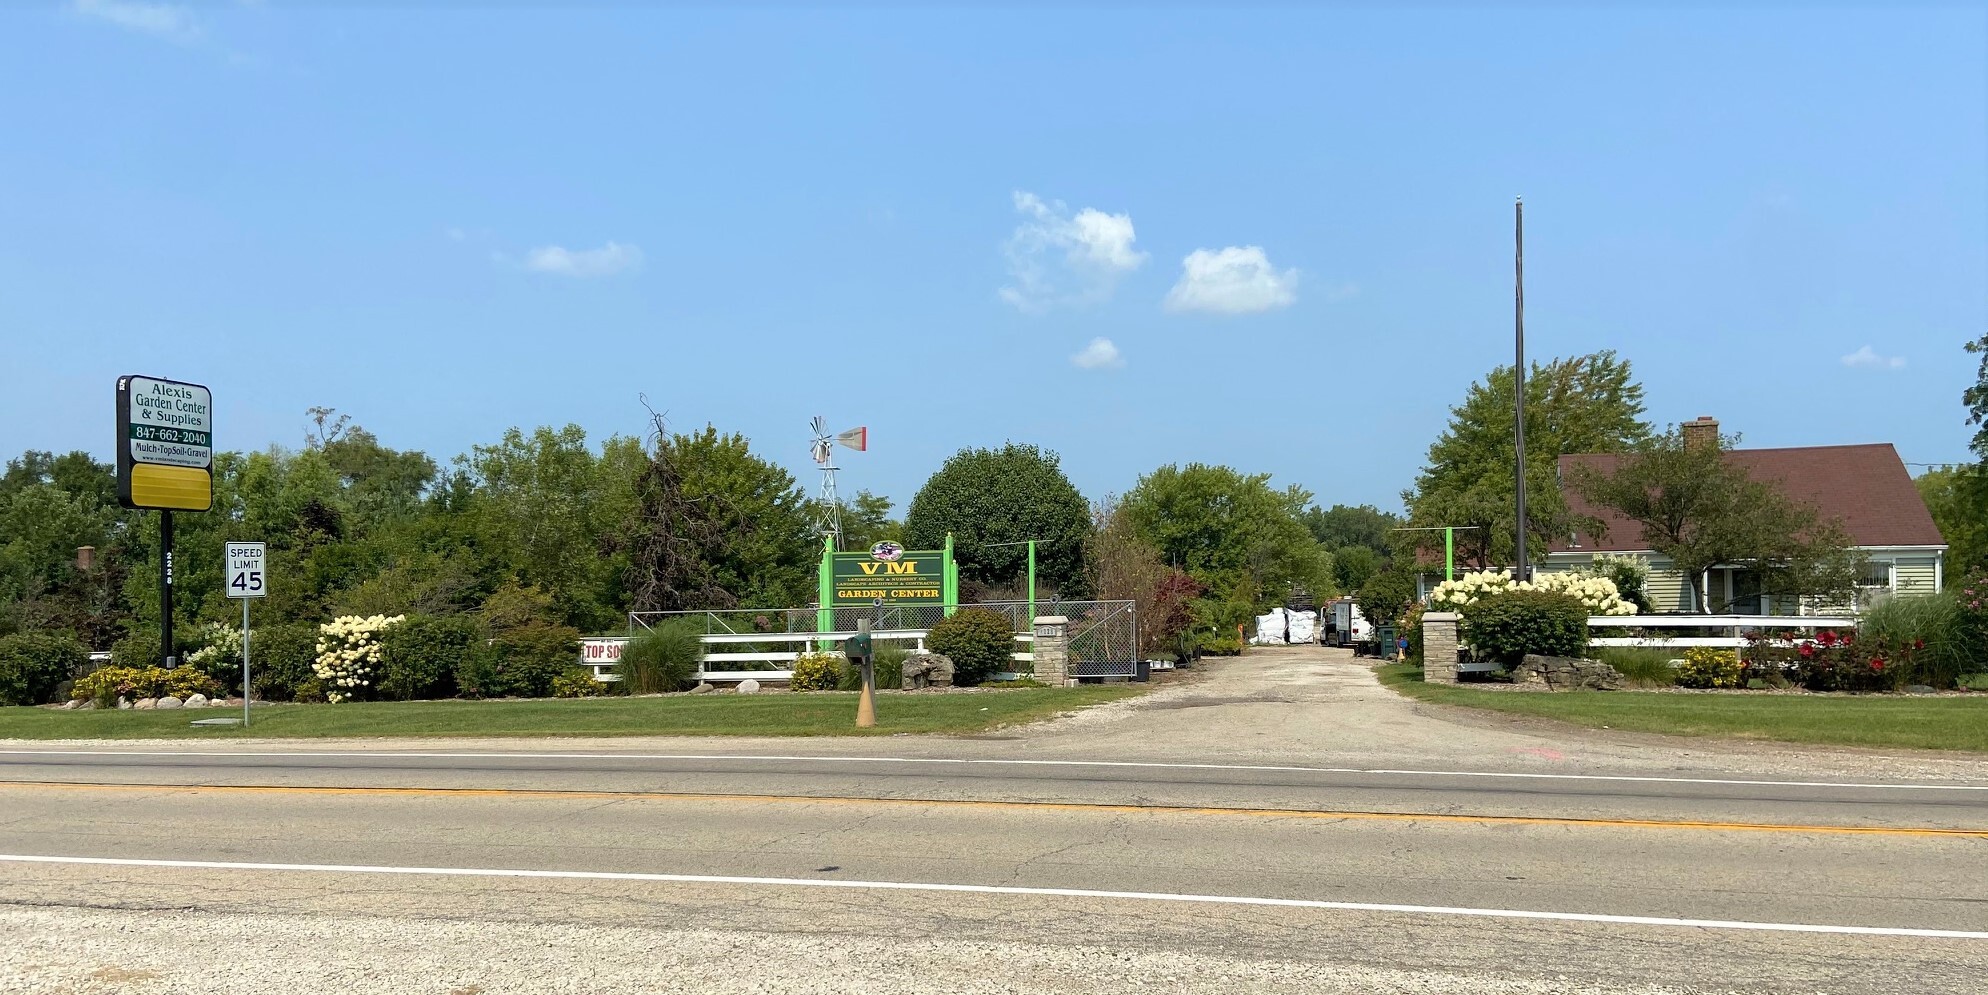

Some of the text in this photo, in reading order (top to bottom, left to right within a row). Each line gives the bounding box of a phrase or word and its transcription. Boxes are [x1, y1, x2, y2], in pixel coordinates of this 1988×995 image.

[152, 383, 192, 399] Alexis
[135, 393, 206, 415] Garden Center
[142, 408, 202, 426] & Supplies
[136, 426, 206, 444] 847-662-2040
[230, 548, 263, 558] SPEED
[233, 560, 259, 569] LIMIT
[857, 561, 918, 575] VM
[231, 571, 263, 591] 45
[837, 589, 939, 598] GARDEN CENTER
[586, 644, 622, 659] TOP SO
